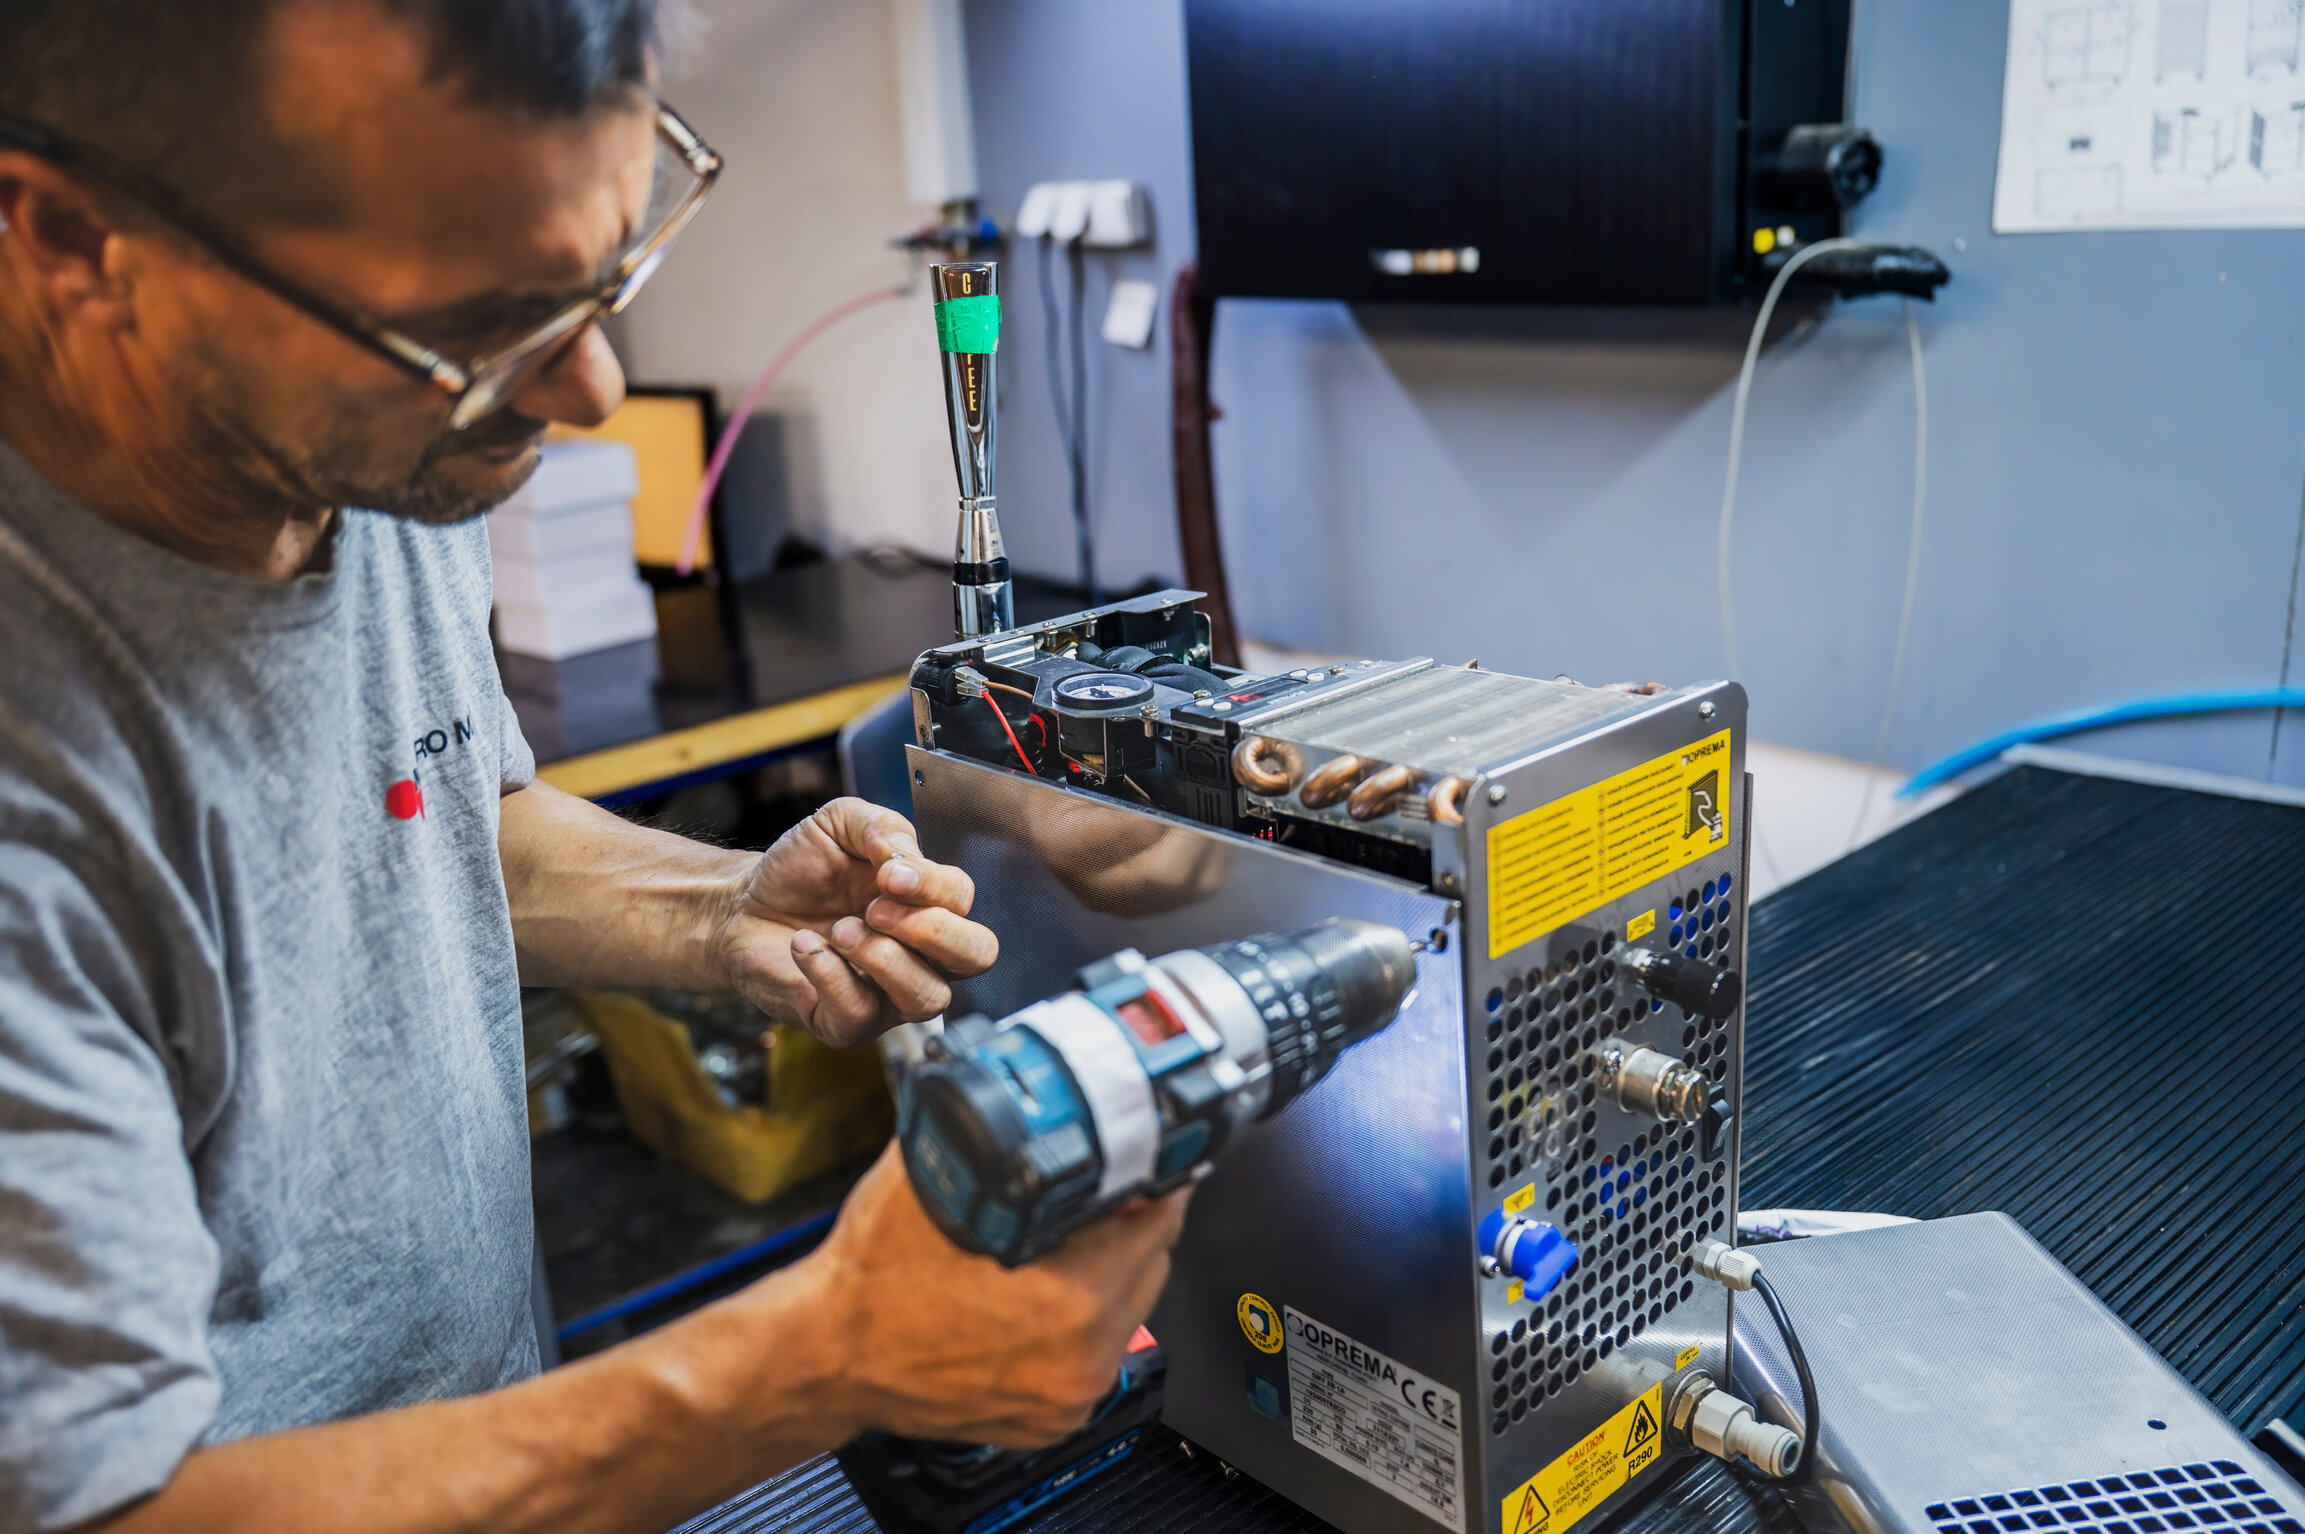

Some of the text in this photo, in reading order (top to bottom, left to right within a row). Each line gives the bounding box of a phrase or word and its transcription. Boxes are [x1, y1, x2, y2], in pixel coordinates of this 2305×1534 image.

[1689, 740, 1725, 764] OPREMA
[1305, 1324, 1397, 1386] OPREMA
[1567, 1430, 1605, 1466] CAUTION
[1628, 1446, 1653, 1474] R290
